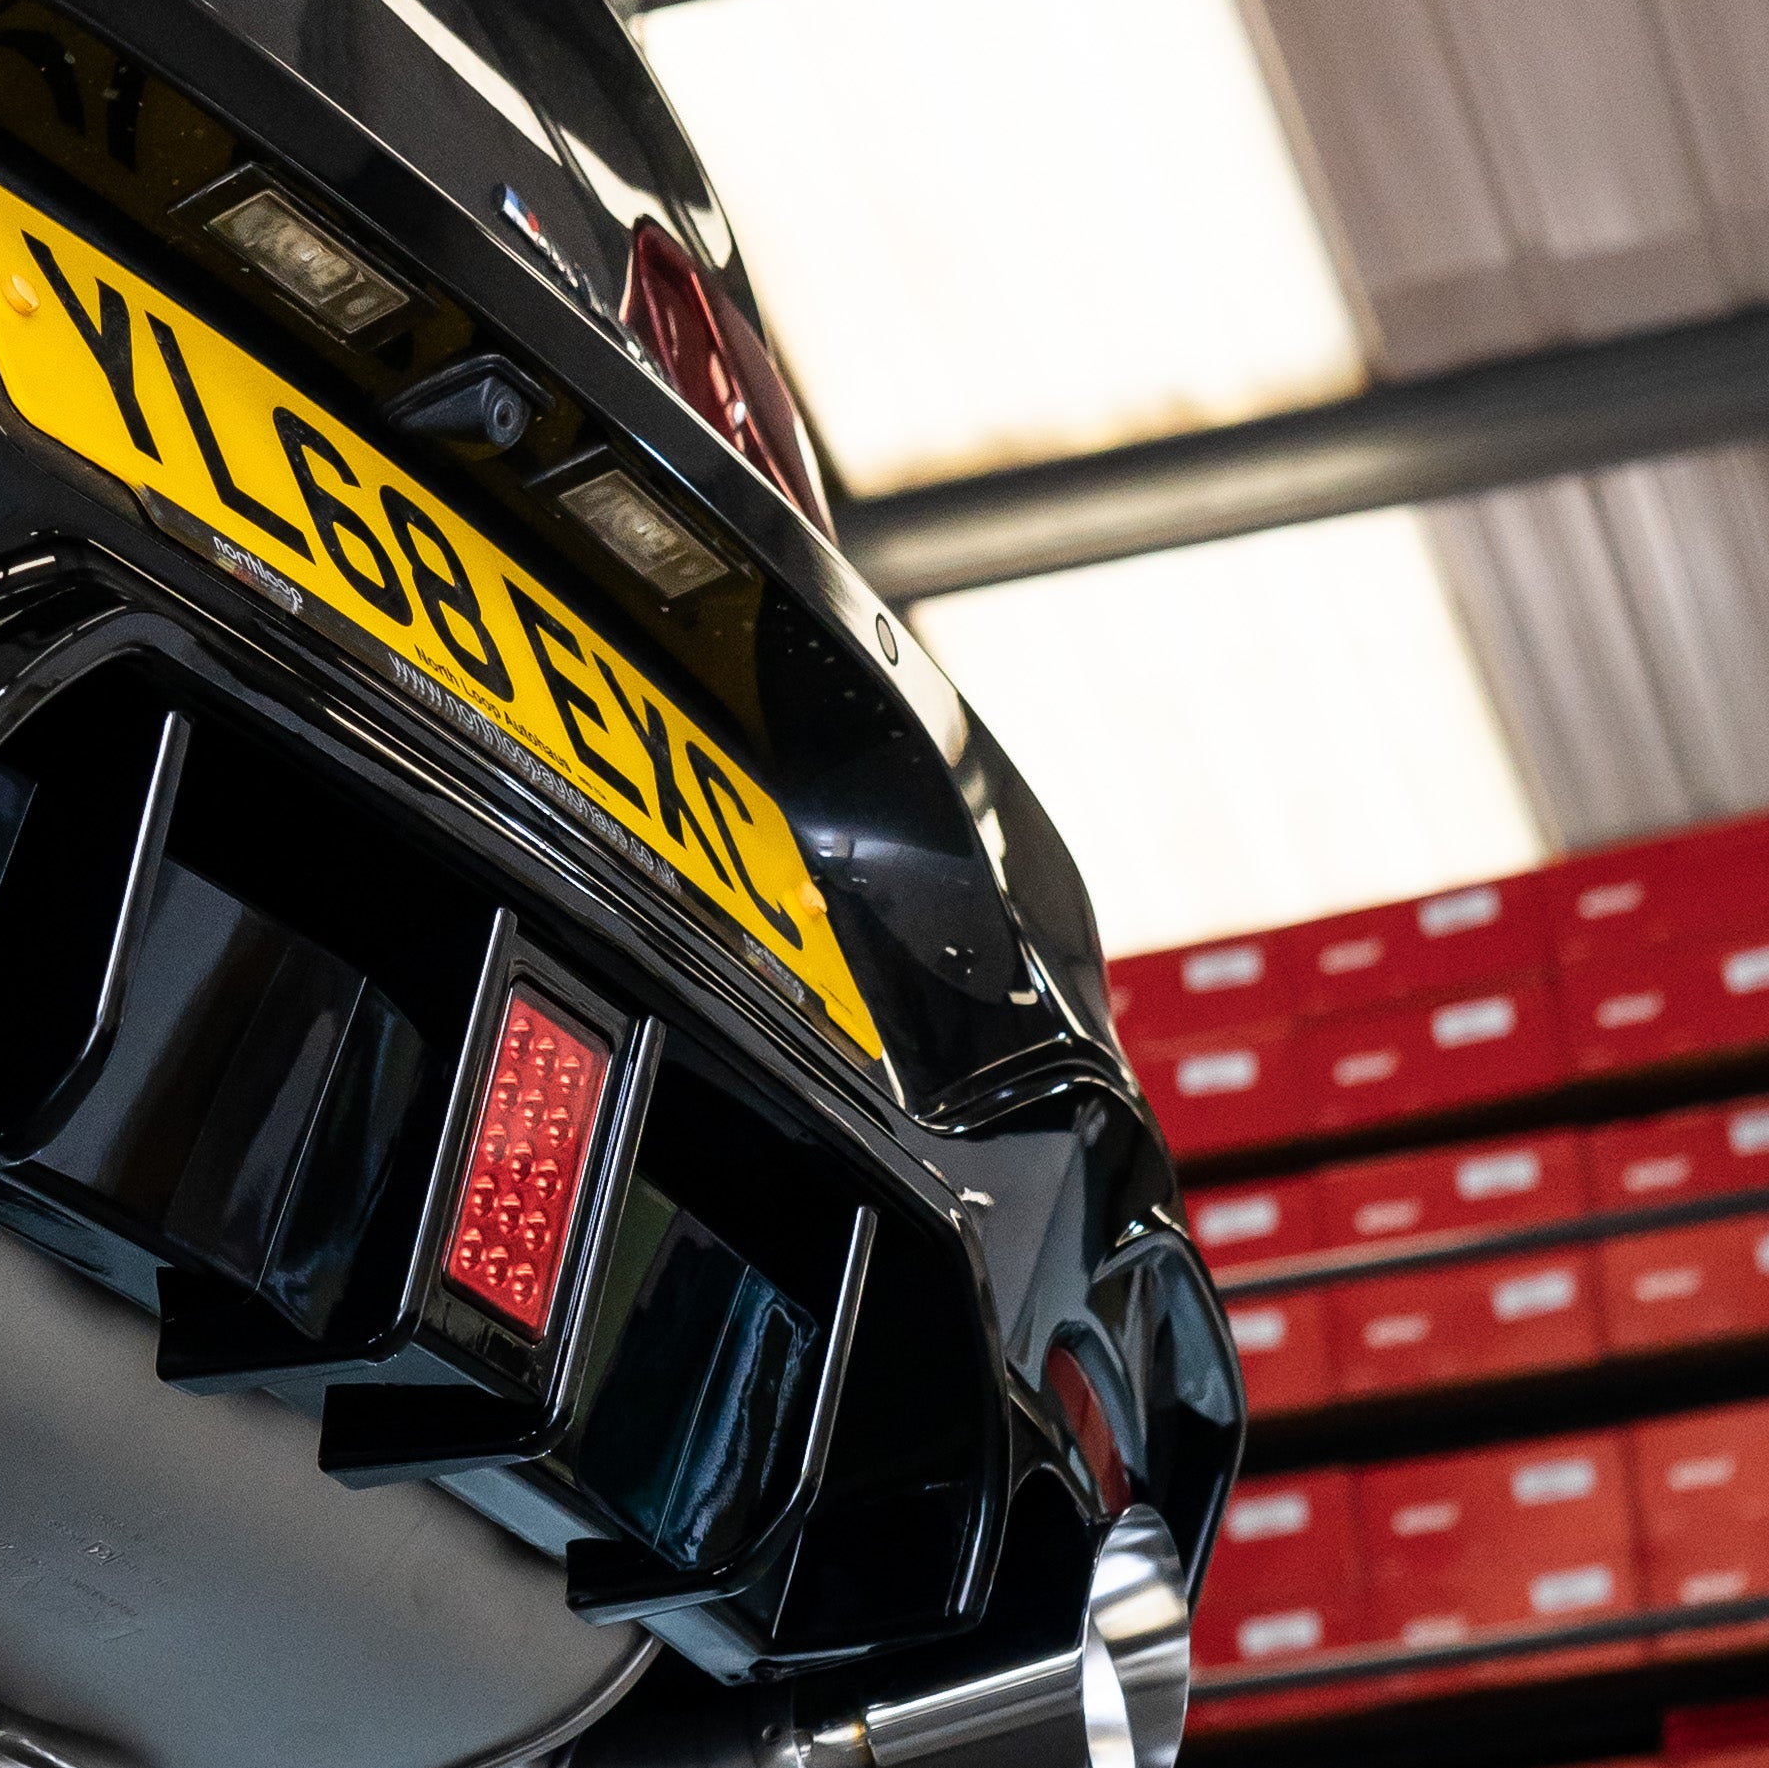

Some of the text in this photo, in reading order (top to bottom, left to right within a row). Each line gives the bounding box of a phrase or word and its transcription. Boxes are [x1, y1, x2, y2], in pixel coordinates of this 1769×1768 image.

[21, 229, 515, 703] YL68
[500, 575, 804, 951] EXC
[212, 535, 303, 614] northloop
[387, 651, 682, 892] www.northloopautohaus.co.uk
[413, 642, 573, 774] North Loop Autohaus
